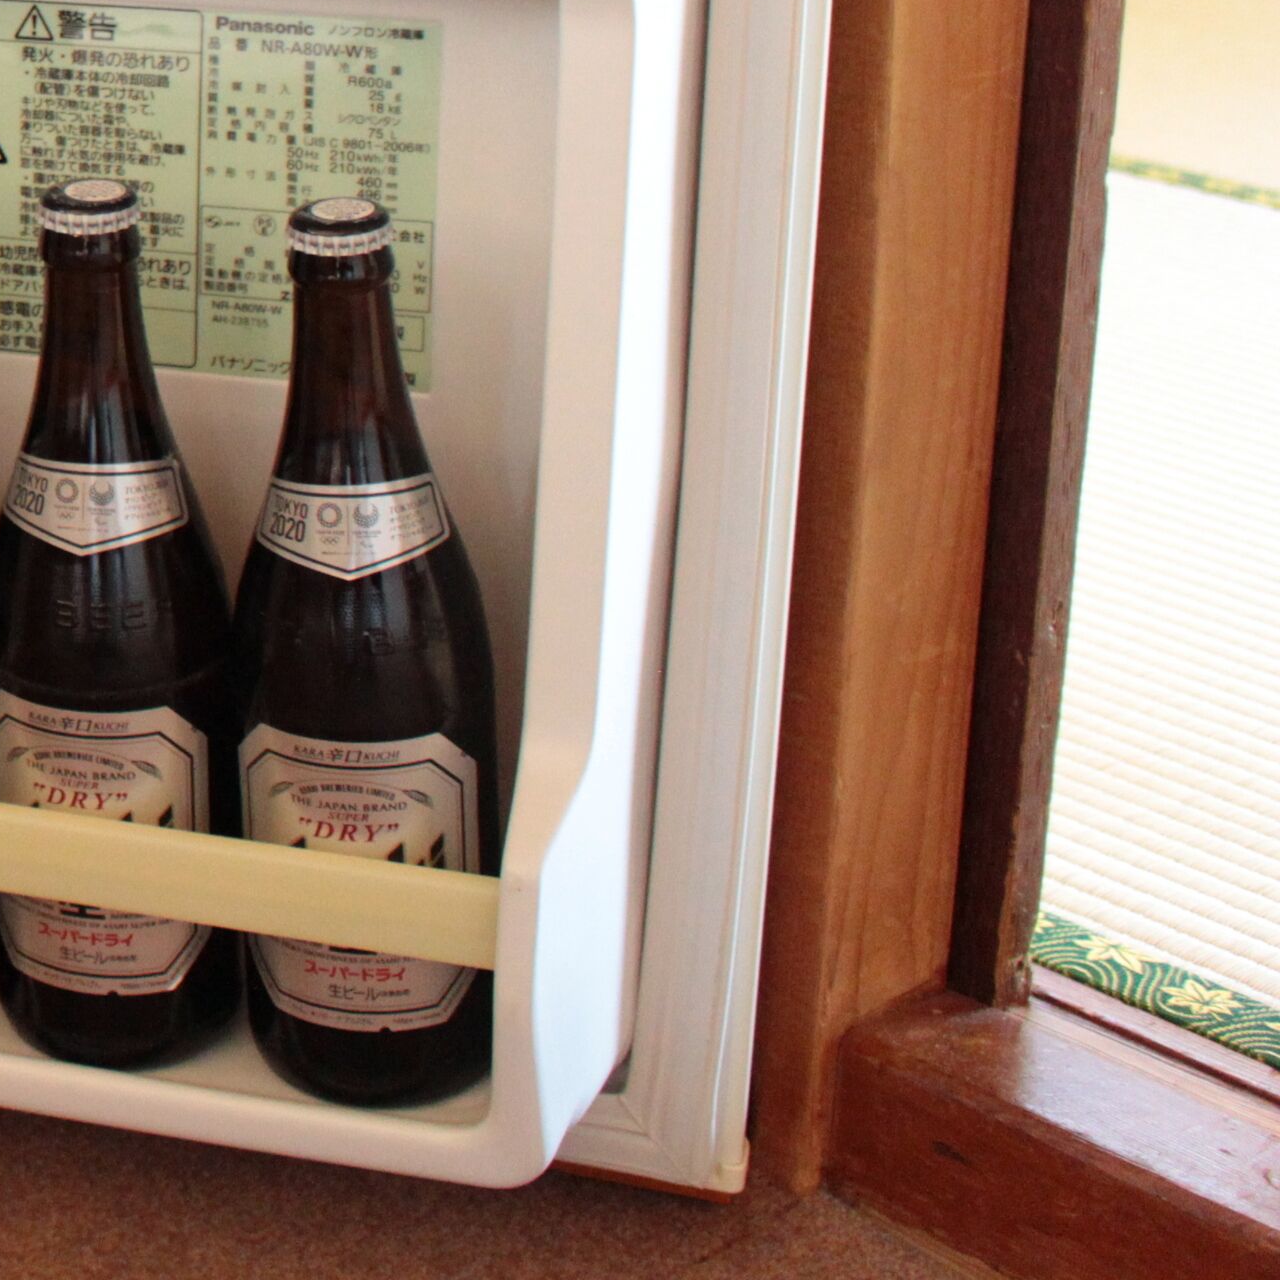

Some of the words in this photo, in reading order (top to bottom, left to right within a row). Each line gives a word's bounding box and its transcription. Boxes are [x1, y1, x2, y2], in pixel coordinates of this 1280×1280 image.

[57, 9, 117, 41] 警告
[215, 15, 314, 36] Panasonic
[327, 24, 425, 40] ノンフロン冷蔵庫
[21, 45, 191, 72] 発火・爆発の恐れあり
[347, 76, 393, 90] R600a
[368, 91, 385, 102] 25
[369, 102, 384, 113] 18
[368, 128, 384, 139] 75
[204, 268, 289, 285] 電動機の定格
[12, 483, 45, 516] 2020
[274, 493, 309, 521] TOKYO
[269, 511, 307, 543] 2020
[62, 716, 92, 732] 辛口
[94, 721, 129, 731] KUCHI
[330, 748, 363, 763] 辛口
[363, 750, 401, 760] KUCHI
[26, 758, 45, 772] THE
[49, 767, 86, 780] JAPAN
[92, 770, 137, 781] BRAND
[59, 778, 99, 790] SUPER
[290, 793, 313, 807] THE
[315, 801, 357, 812] JAPAN
[362, 801, 408, 813] BRAND
[328, 812, 370, 822] SUPER
[38, 921, 134, 948] スーパードライ
[303, 959, 407, 982] スーパードライ
